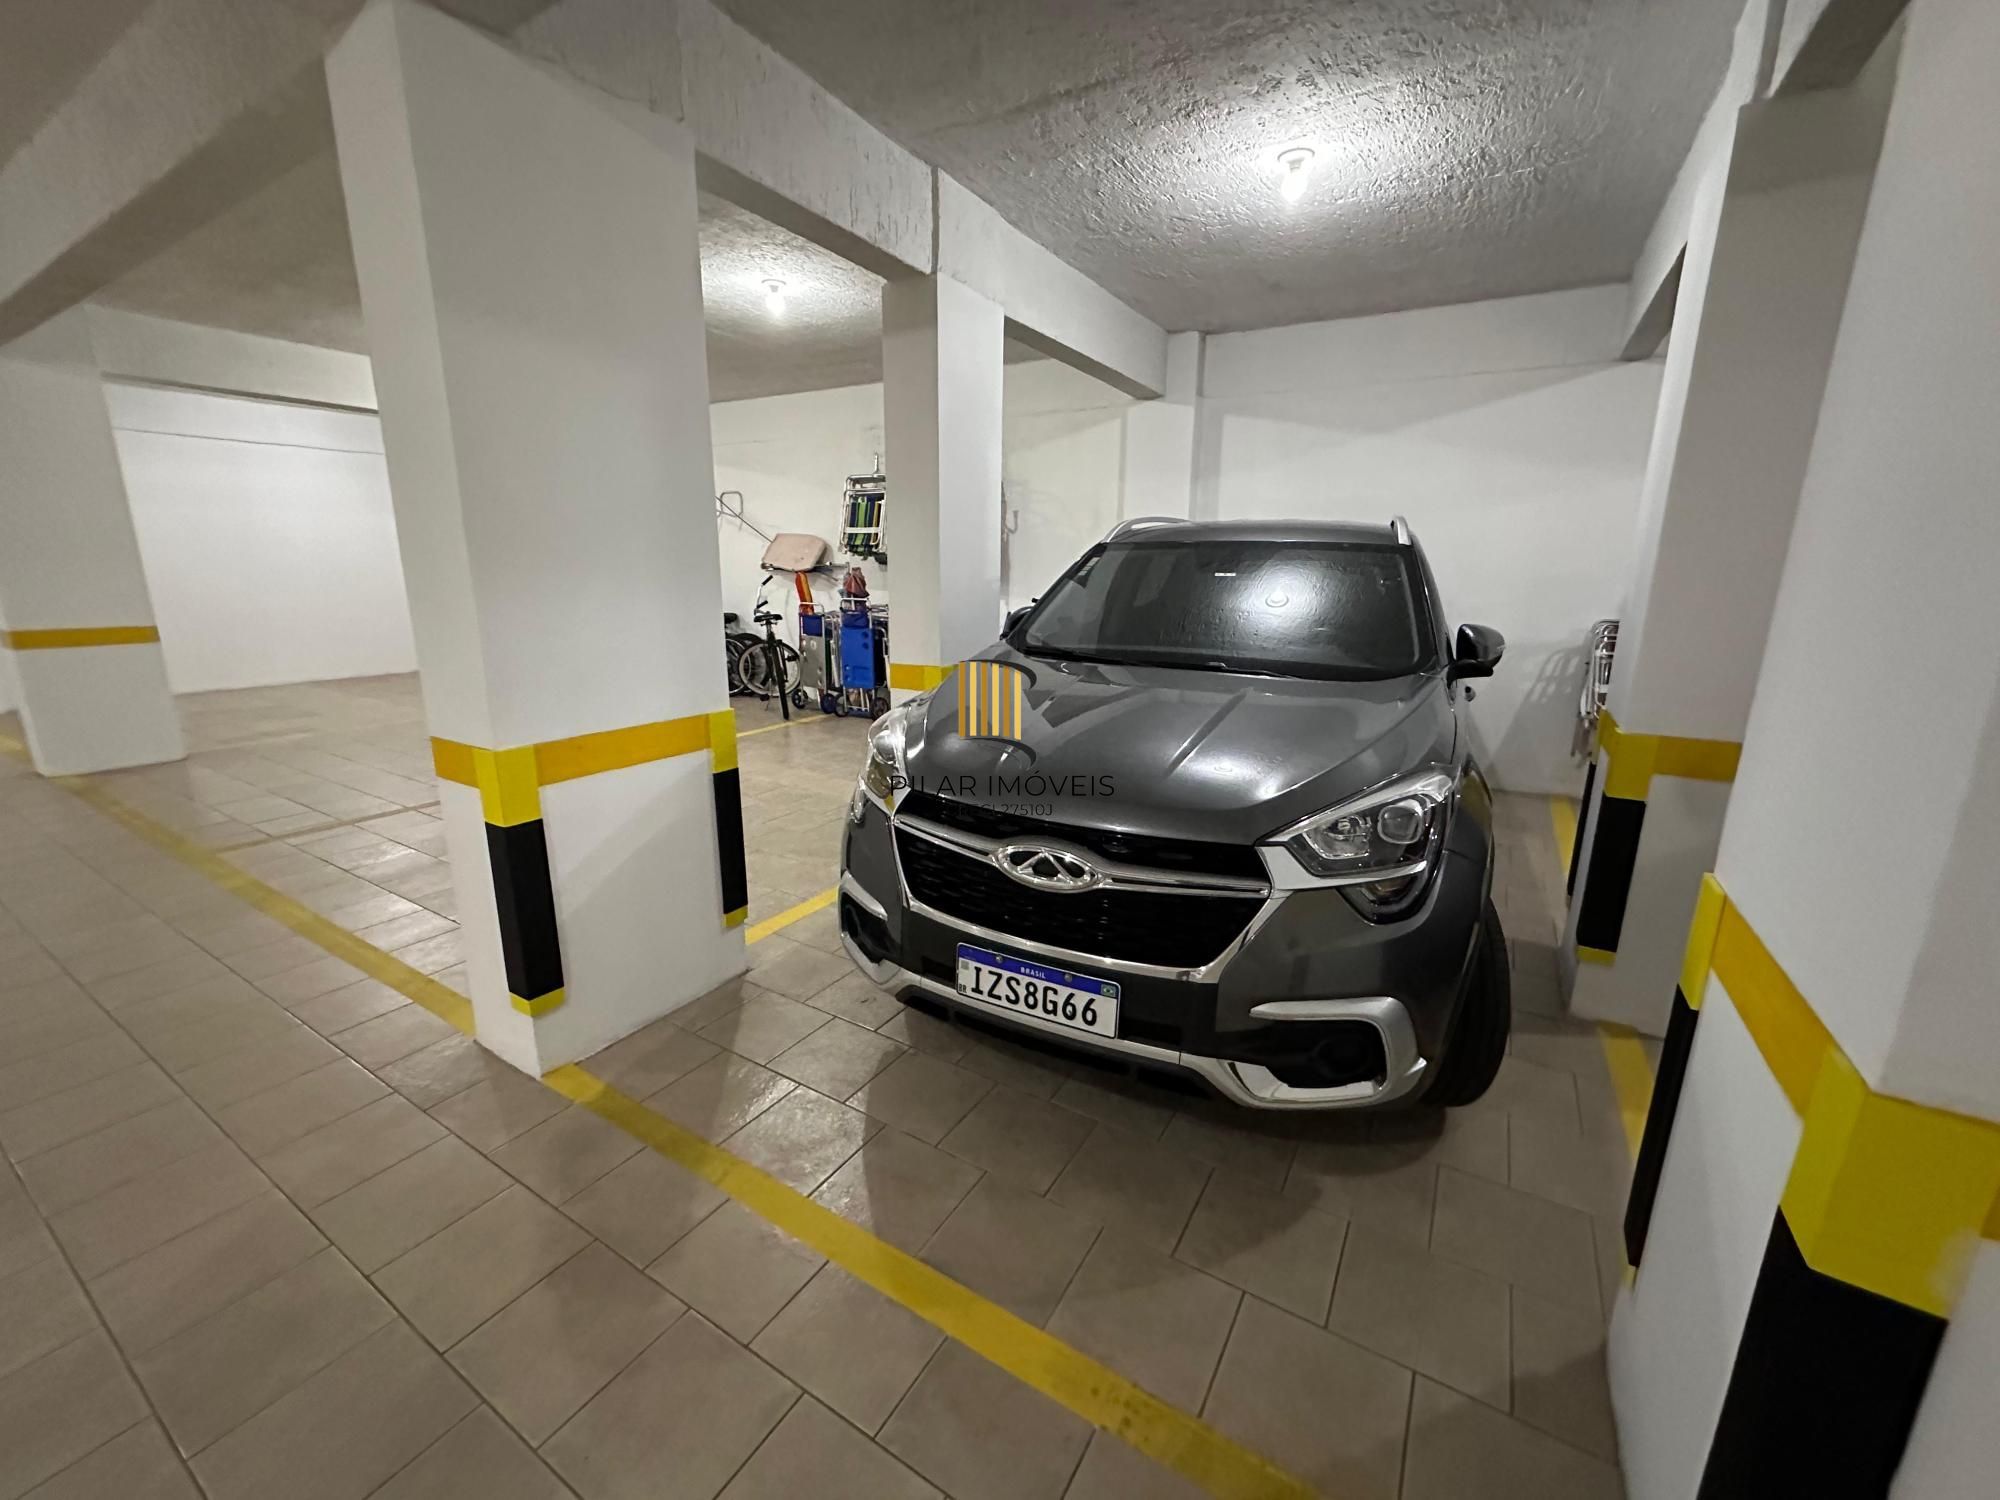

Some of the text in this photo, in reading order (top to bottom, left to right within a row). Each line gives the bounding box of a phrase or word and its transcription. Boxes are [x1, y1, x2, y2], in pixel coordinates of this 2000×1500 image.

[1019, 966, 1046, 979] BRASIL
[958, 983, 967, 994] BR
[971, 965, 1098, 1027] IZS8G66
